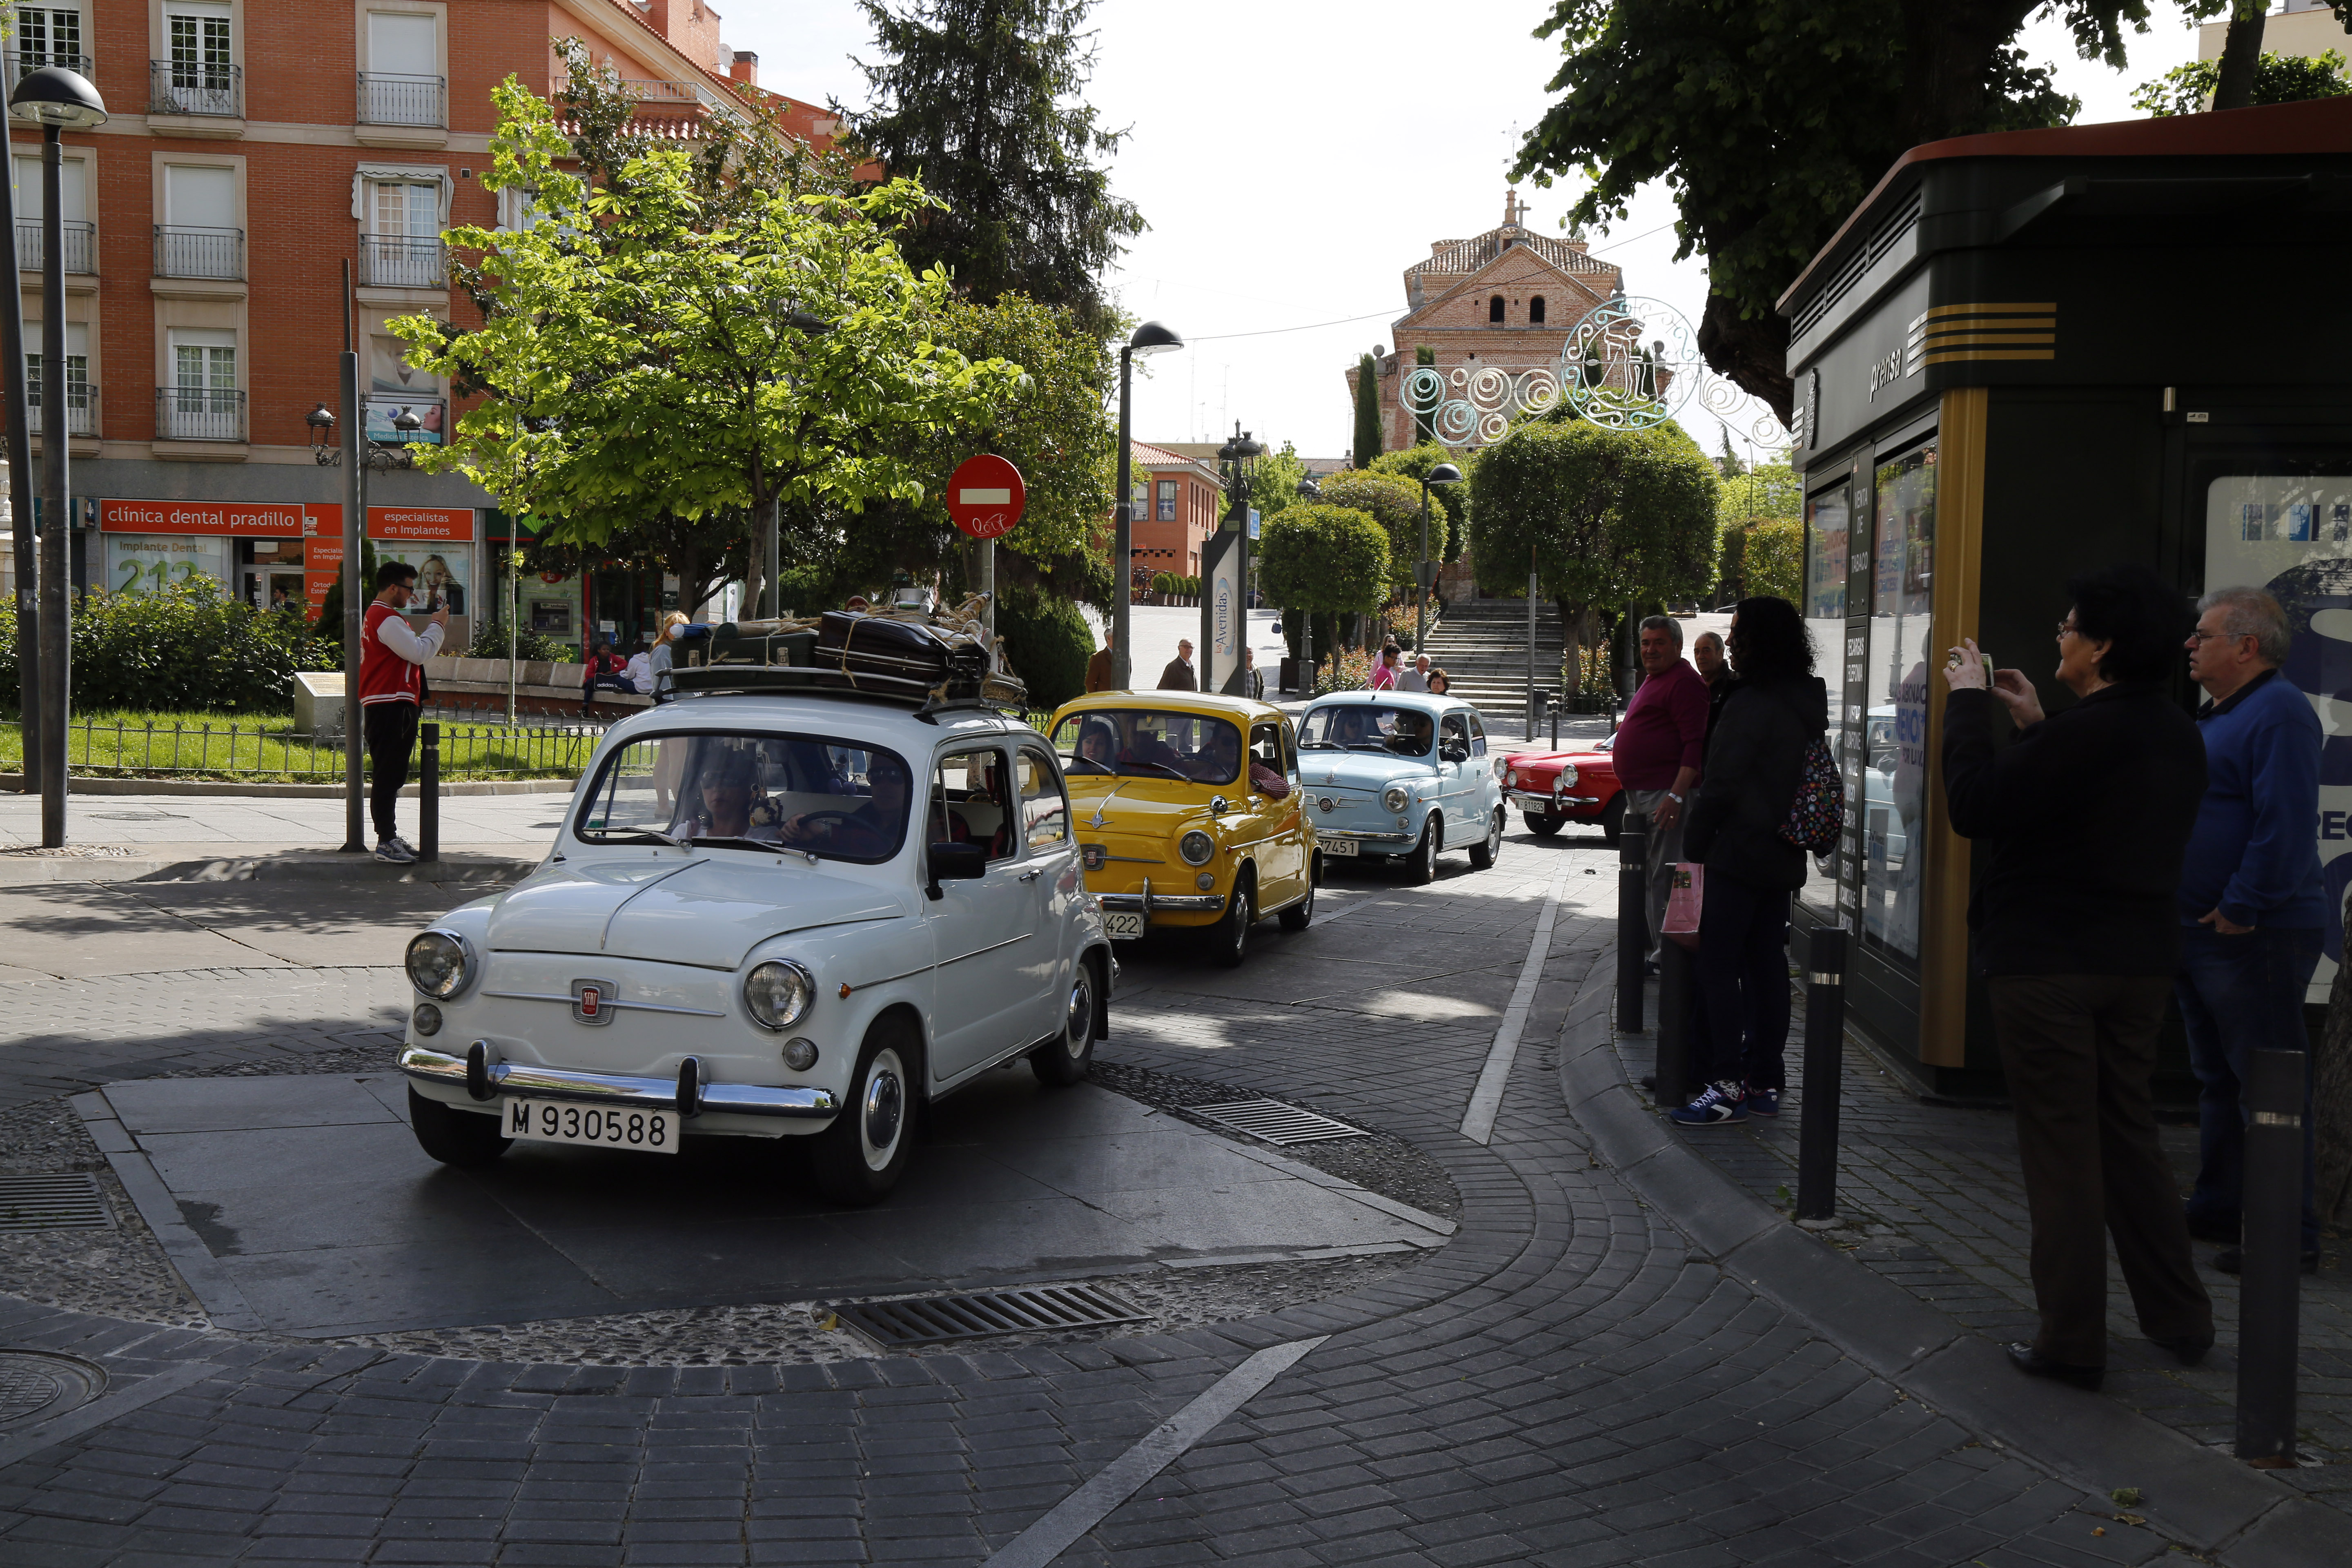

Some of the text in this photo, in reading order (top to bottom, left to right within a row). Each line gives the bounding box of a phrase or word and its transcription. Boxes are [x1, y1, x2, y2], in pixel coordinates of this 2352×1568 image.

[1869, 348, 1901, 403] prensa
[1855, 488, 1868, 509] VENTA
[108, 506, 164, 523] clínica
[170, 509, 224, 525] dental
[230, 511, 294, 528] pradillo
[384, 512, 449, 523] especialistas
[1857, 514, 1864, 534] DE
[401, 525, 450, 536] Implantes
[120, 541, 207, 553] Implante Dental
[1851, 551, 1868, 573] TABACO
[1216, 592, 1227, 645] Avenidas
[1524, 801, 1544, 812] 811825
[584, 992, 597, 1006] SEAT
[512, 1102, 665, 1146] M 930588
